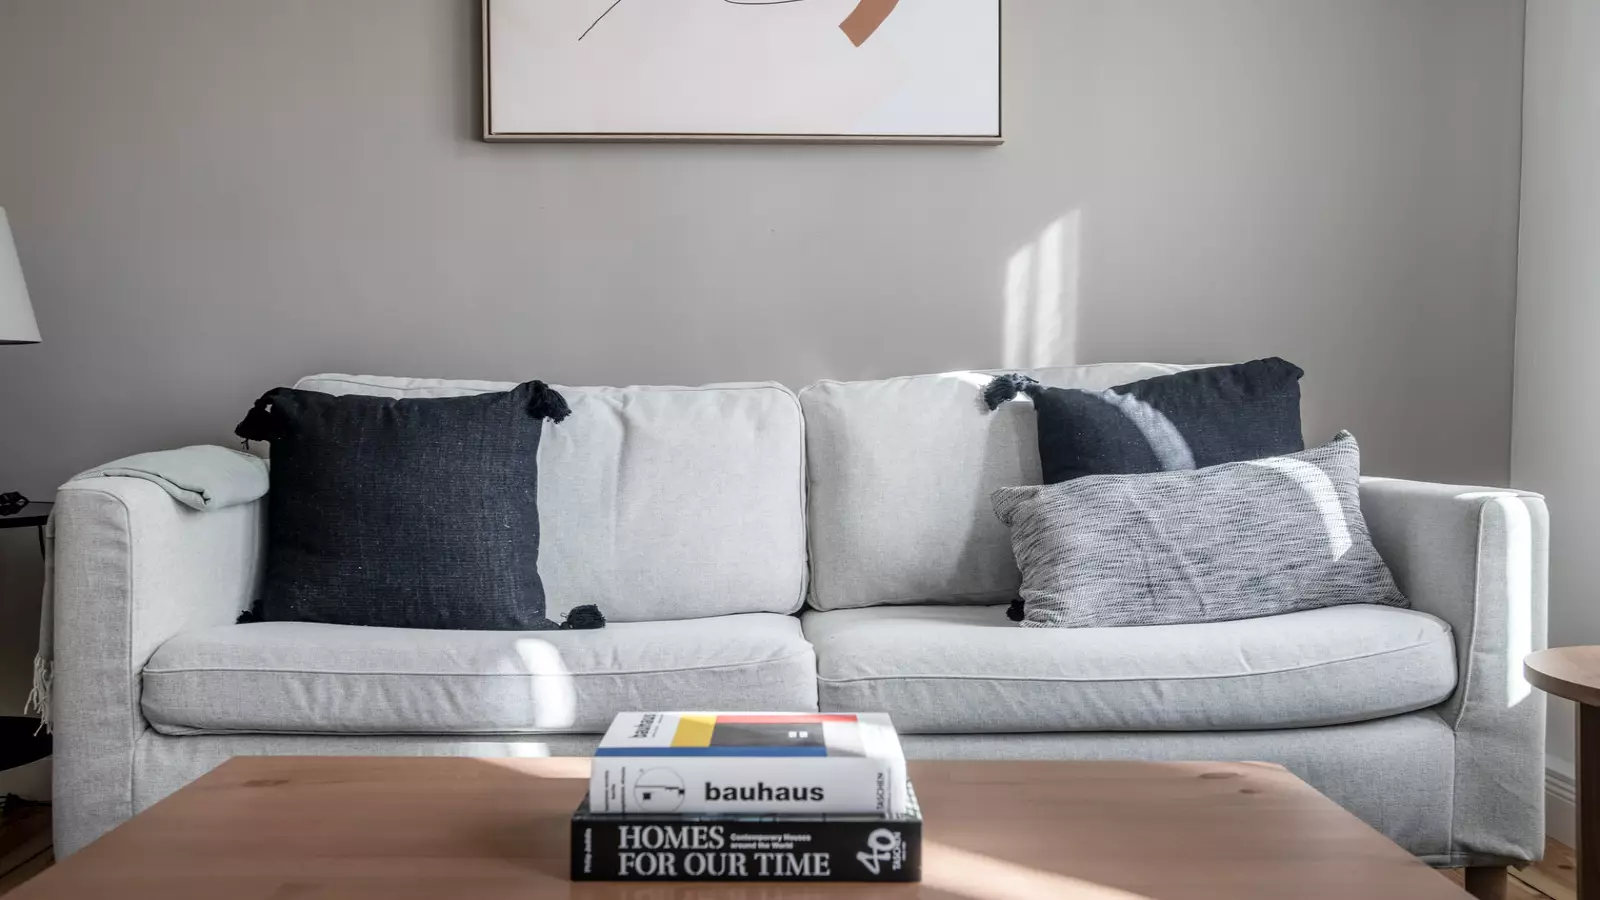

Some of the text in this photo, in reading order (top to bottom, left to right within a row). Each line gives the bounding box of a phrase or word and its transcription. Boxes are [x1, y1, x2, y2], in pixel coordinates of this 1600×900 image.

[628, 714, 656, 738] bauhaus
[705, 782, 825, 801] bauhaus
[876, 772, 885, 810] TASCHEN
[618, 825, 725, 849] HOMES
[730, 833, 812, 842] Contemporary Houses
[856, 828, 896, 875] 40
[892, 832, 901, 871] TASCHEN
[618, 852, 831, 876] FOR OUR TIME
